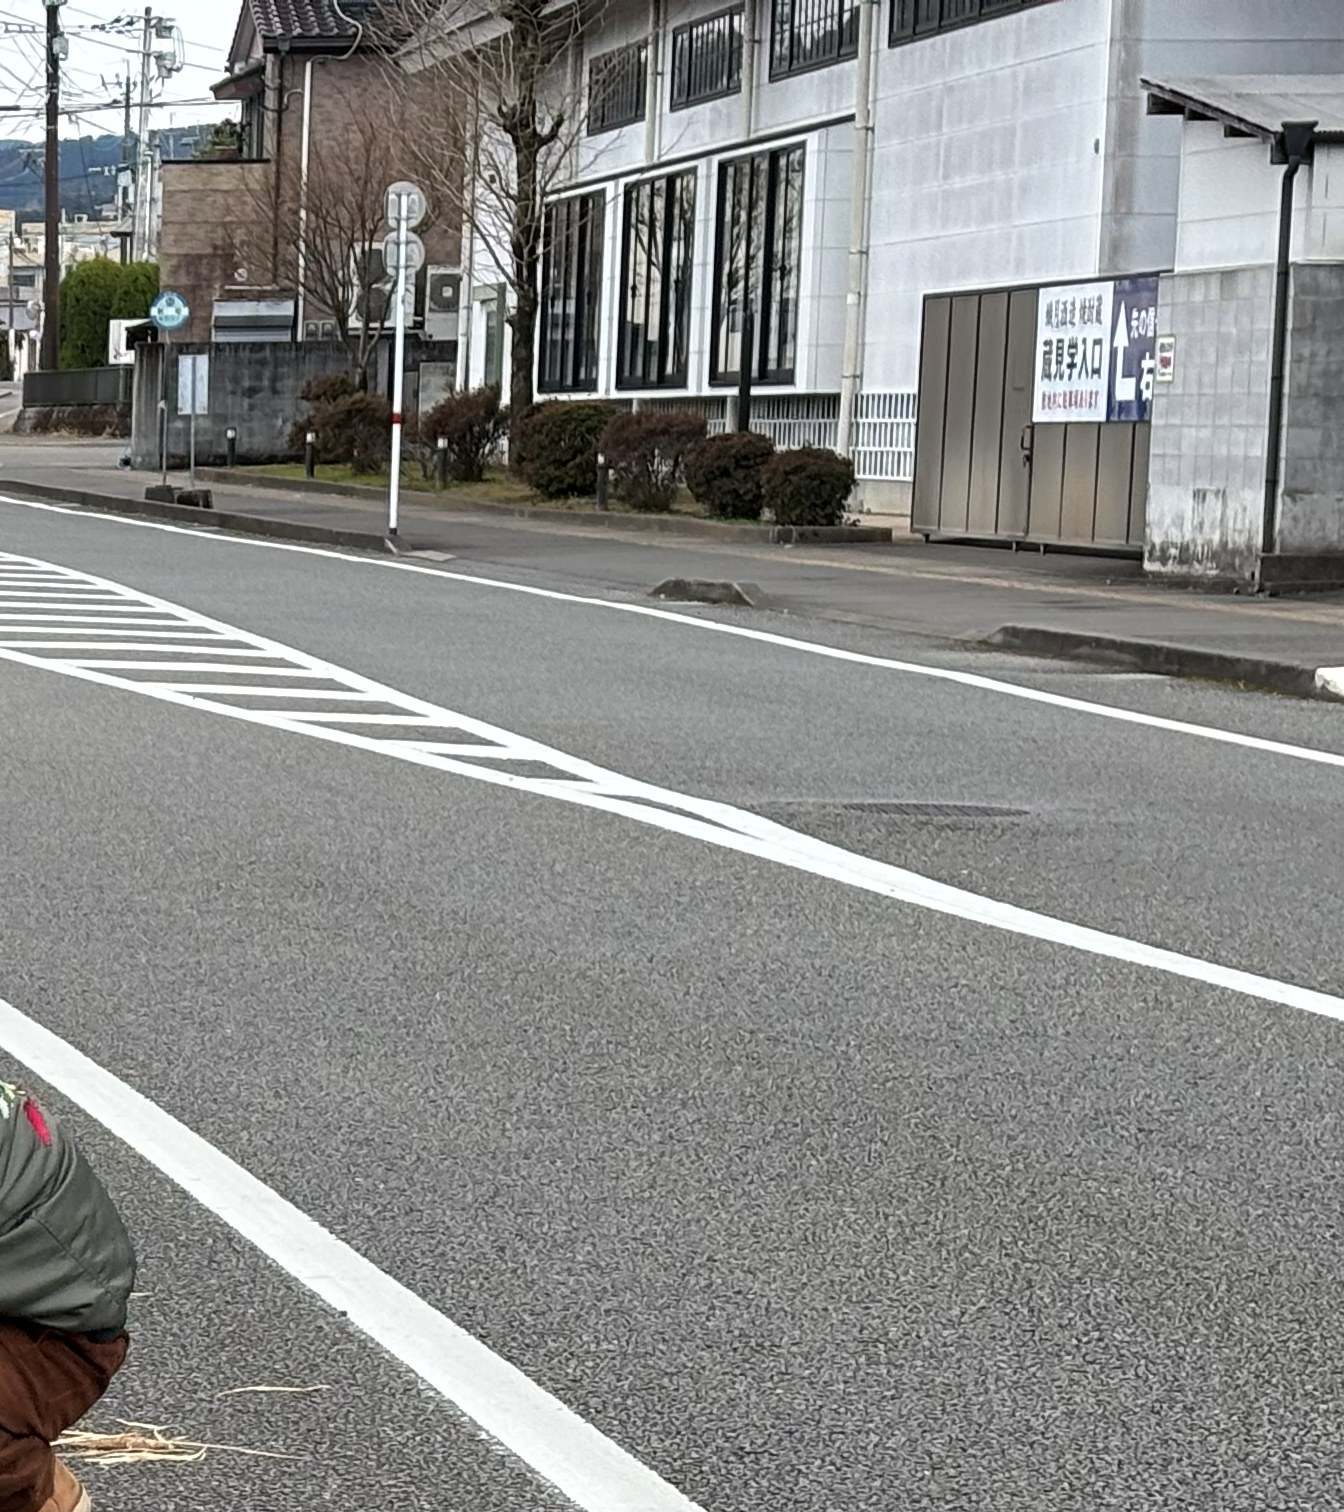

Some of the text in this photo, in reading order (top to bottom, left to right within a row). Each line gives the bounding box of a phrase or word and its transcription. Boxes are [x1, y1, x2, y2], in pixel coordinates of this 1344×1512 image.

[1041, 336, 1103, 381] 蔵見学入口
